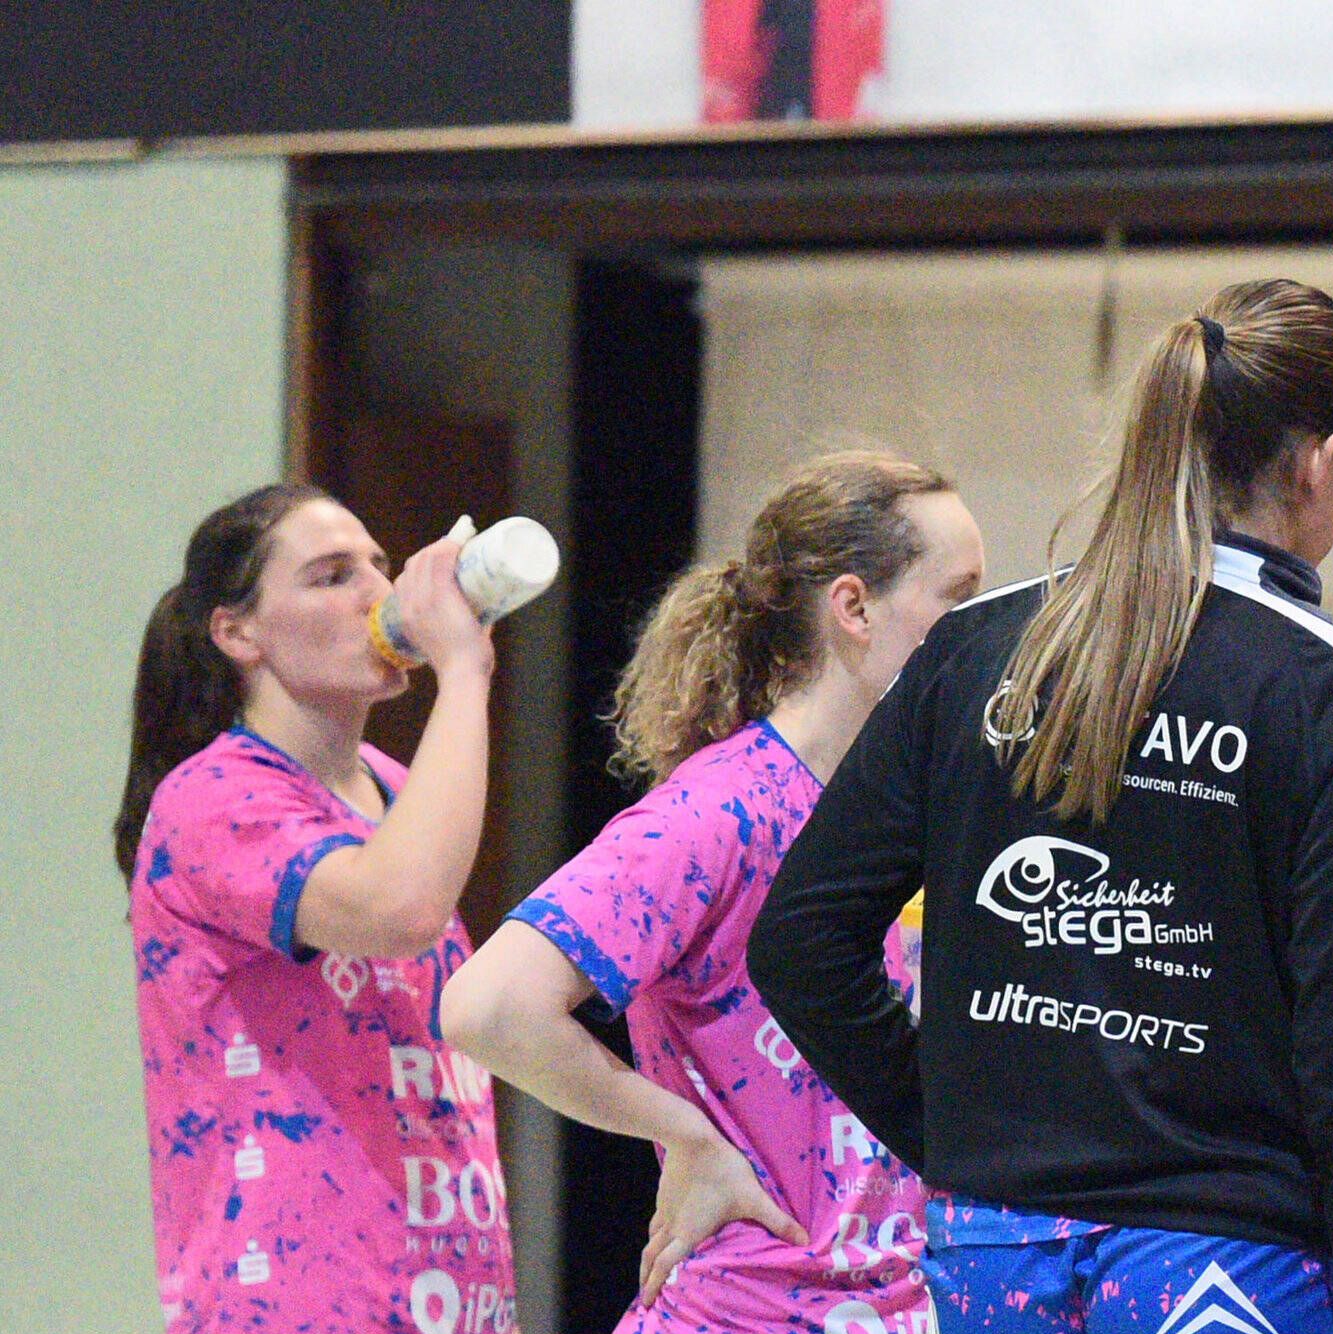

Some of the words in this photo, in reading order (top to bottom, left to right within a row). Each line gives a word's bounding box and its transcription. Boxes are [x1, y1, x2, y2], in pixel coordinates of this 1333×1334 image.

[1140, 712, 1248, 774] AVO
[1122, 773, 1178, 795] sourcen.
[1180, 779, 1240, 808] Effizienz.
[1056, 880, 1175, 911] Sicherheit
[1021, 910, 1152, 954] stega
[1154, 922, 1213, 944] GmbH
[1134, 956, 1213, 980] stega.tv
[969, 983, 1210, 1055] ultraSPORTS
